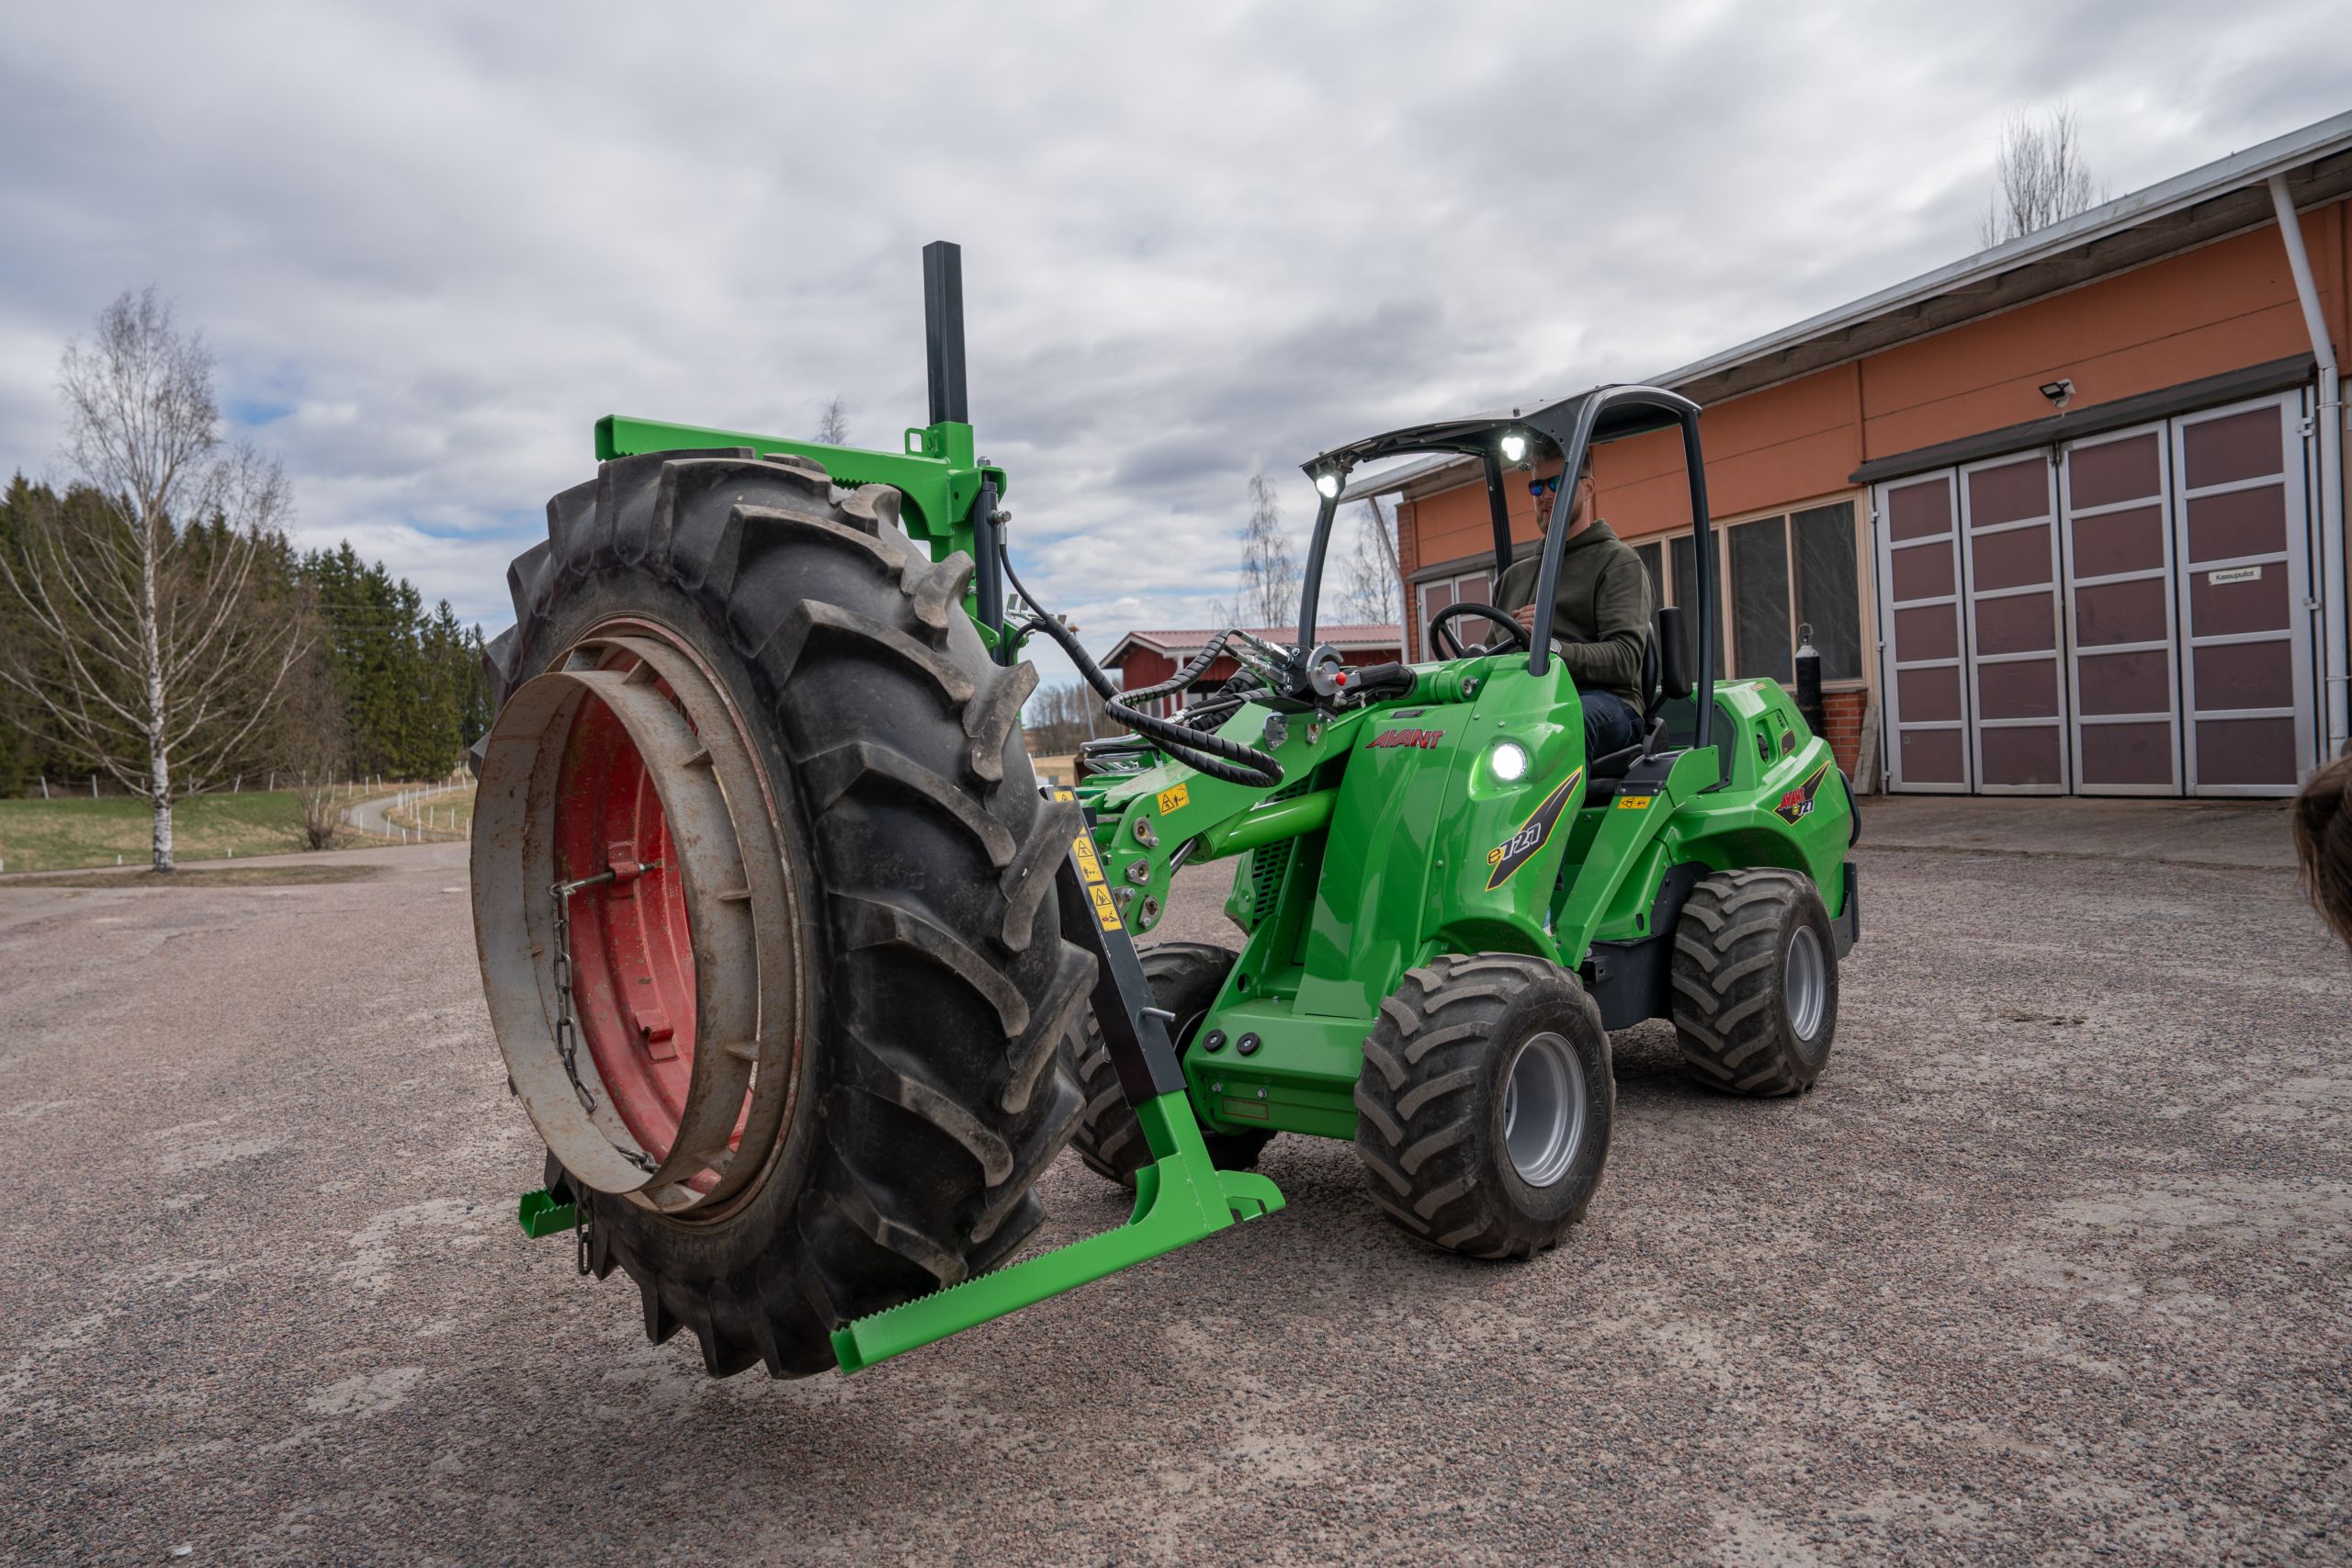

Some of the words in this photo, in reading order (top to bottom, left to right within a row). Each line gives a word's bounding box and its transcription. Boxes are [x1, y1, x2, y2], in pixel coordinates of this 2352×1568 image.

[1365, 728, 1444, 750] AVANT
[1779, 787, 1805, 810] AVANT
[1792, 799, 1815, 816] e727
[1487, 823, 1541, 864] e727
